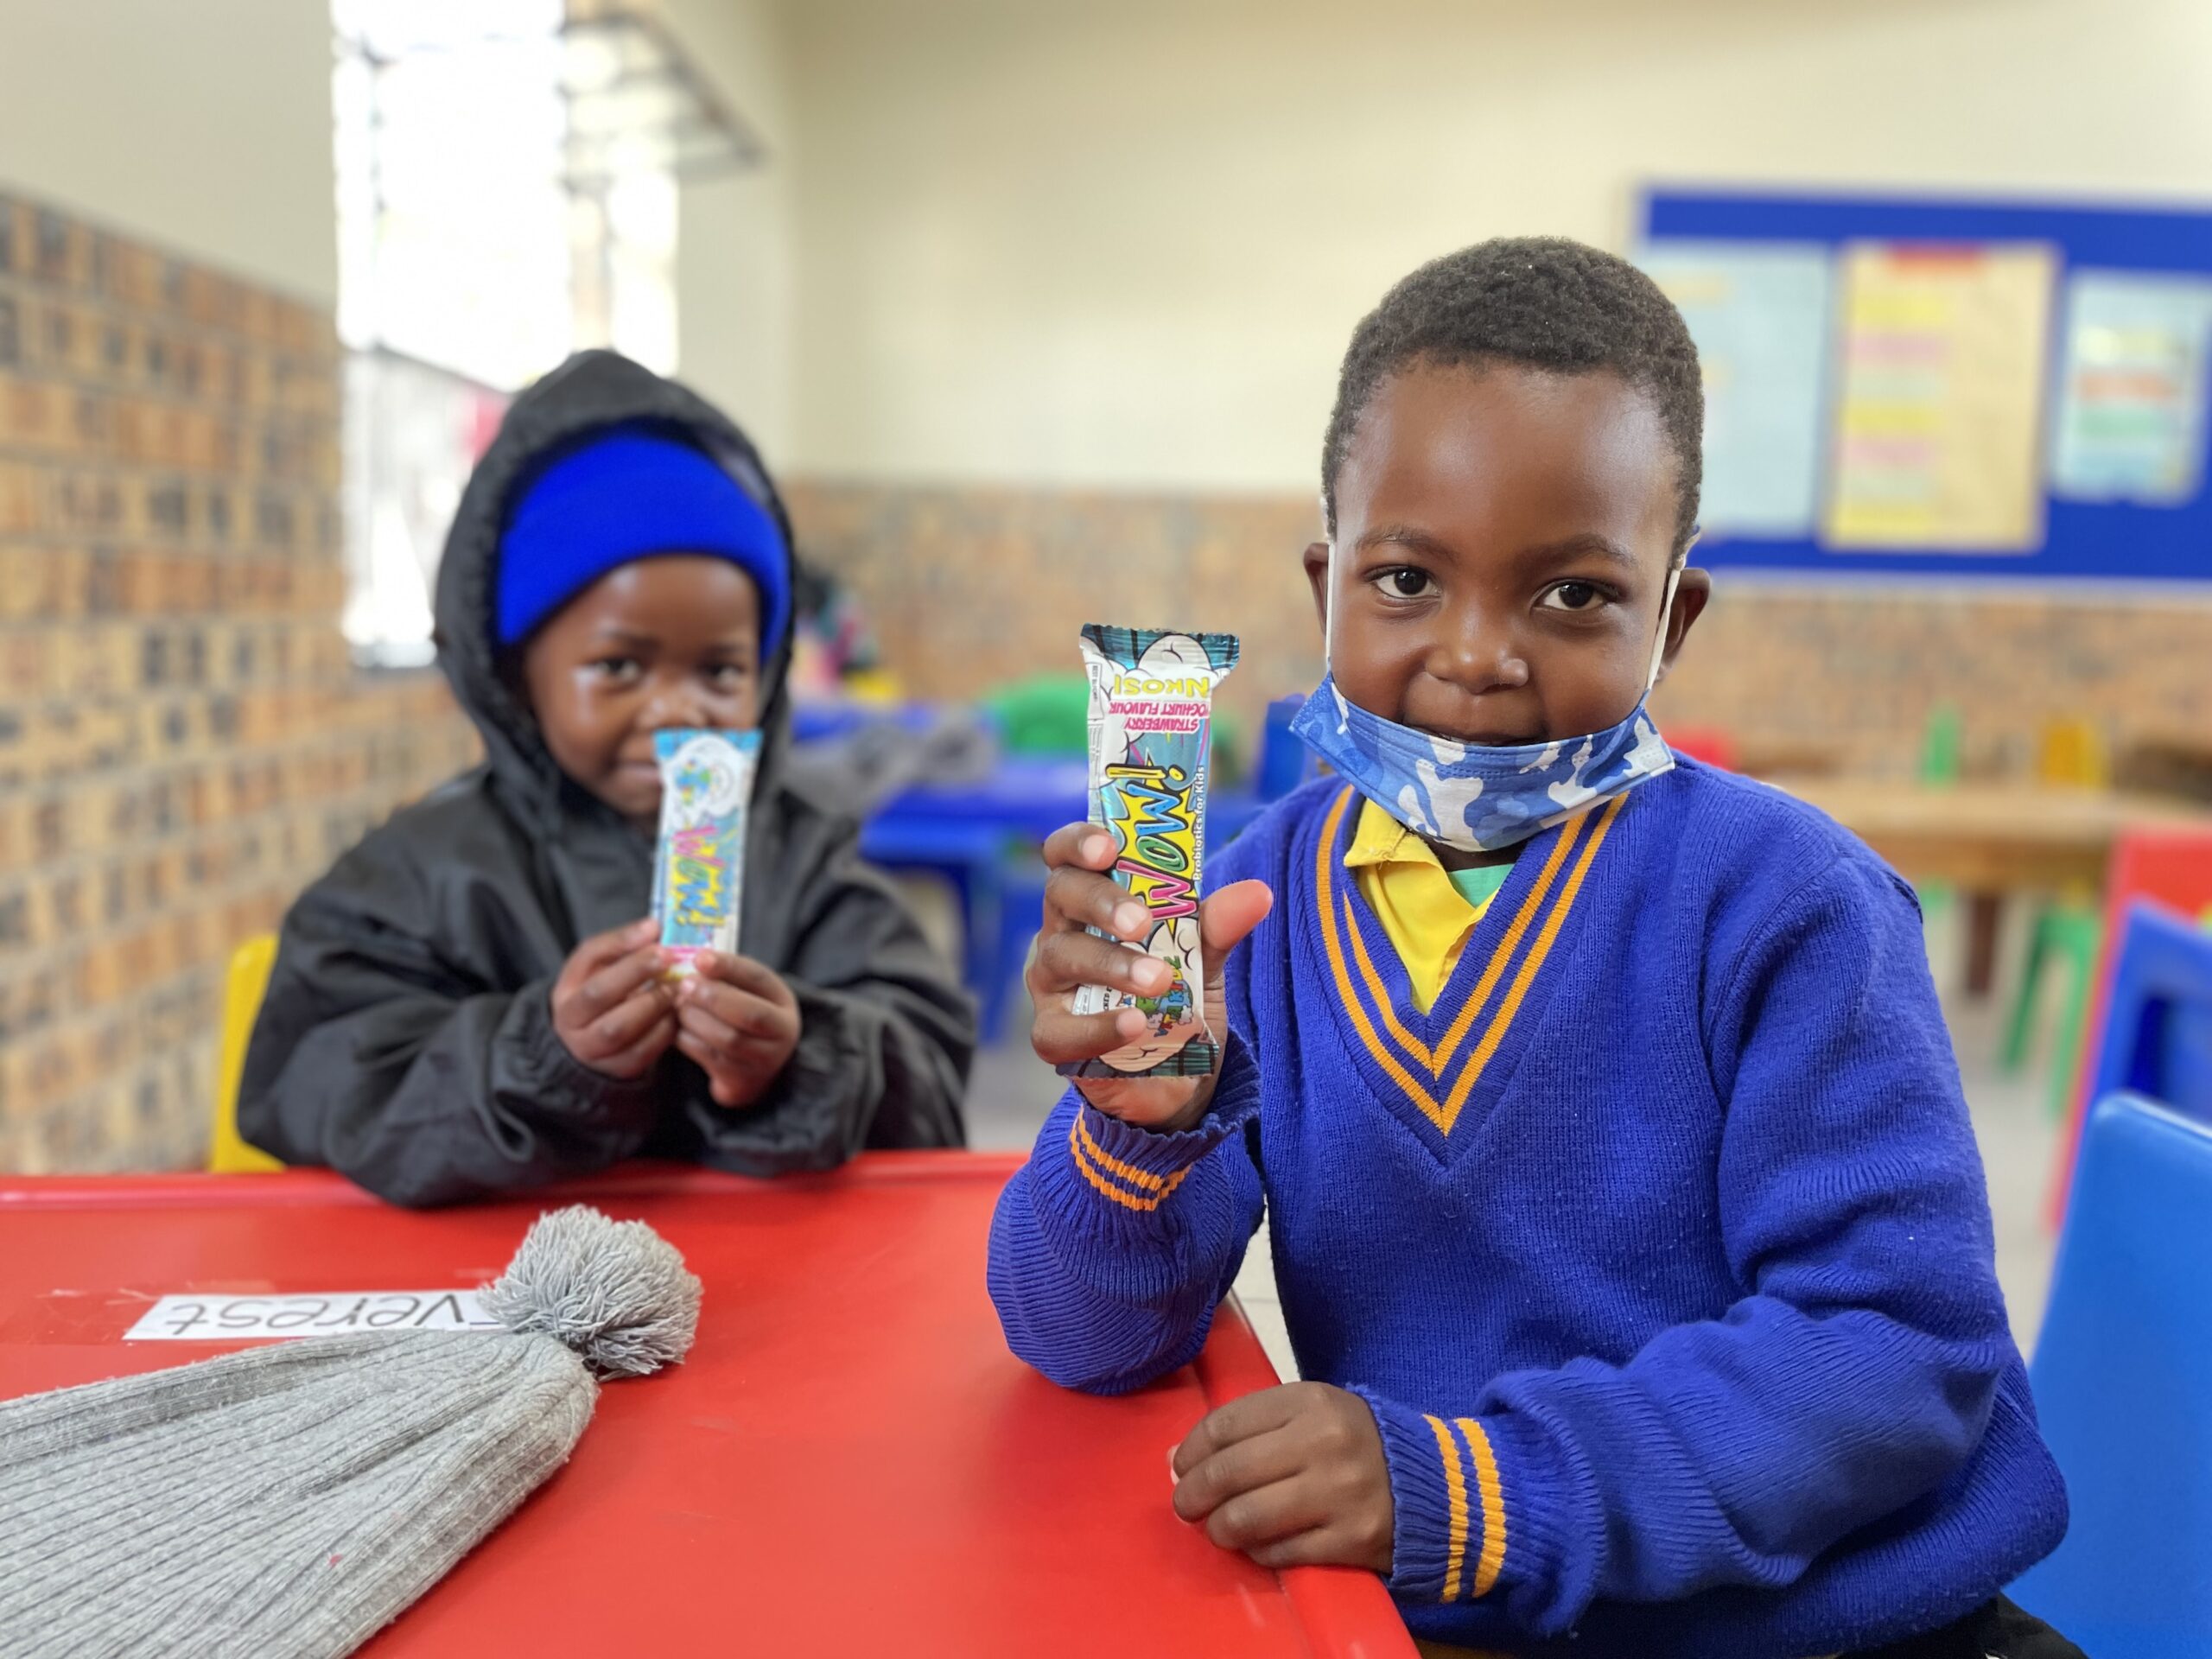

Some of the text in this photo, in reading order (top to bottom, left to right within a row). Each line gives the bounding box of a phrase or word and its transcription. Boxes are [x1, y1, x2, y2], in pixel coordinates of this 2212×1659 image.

[1114, 675, 1210, 698] NKOSI
[1109, 702, 1160, 715] FLAVOUR
[1123, 717, 1198, 731] STRAWBERRY
[1192, 766, 1205, 881] Probiotics for Kids
[1104, 763, 1199, 921] WOW!
[166, 1294, 499, 1335] verest
